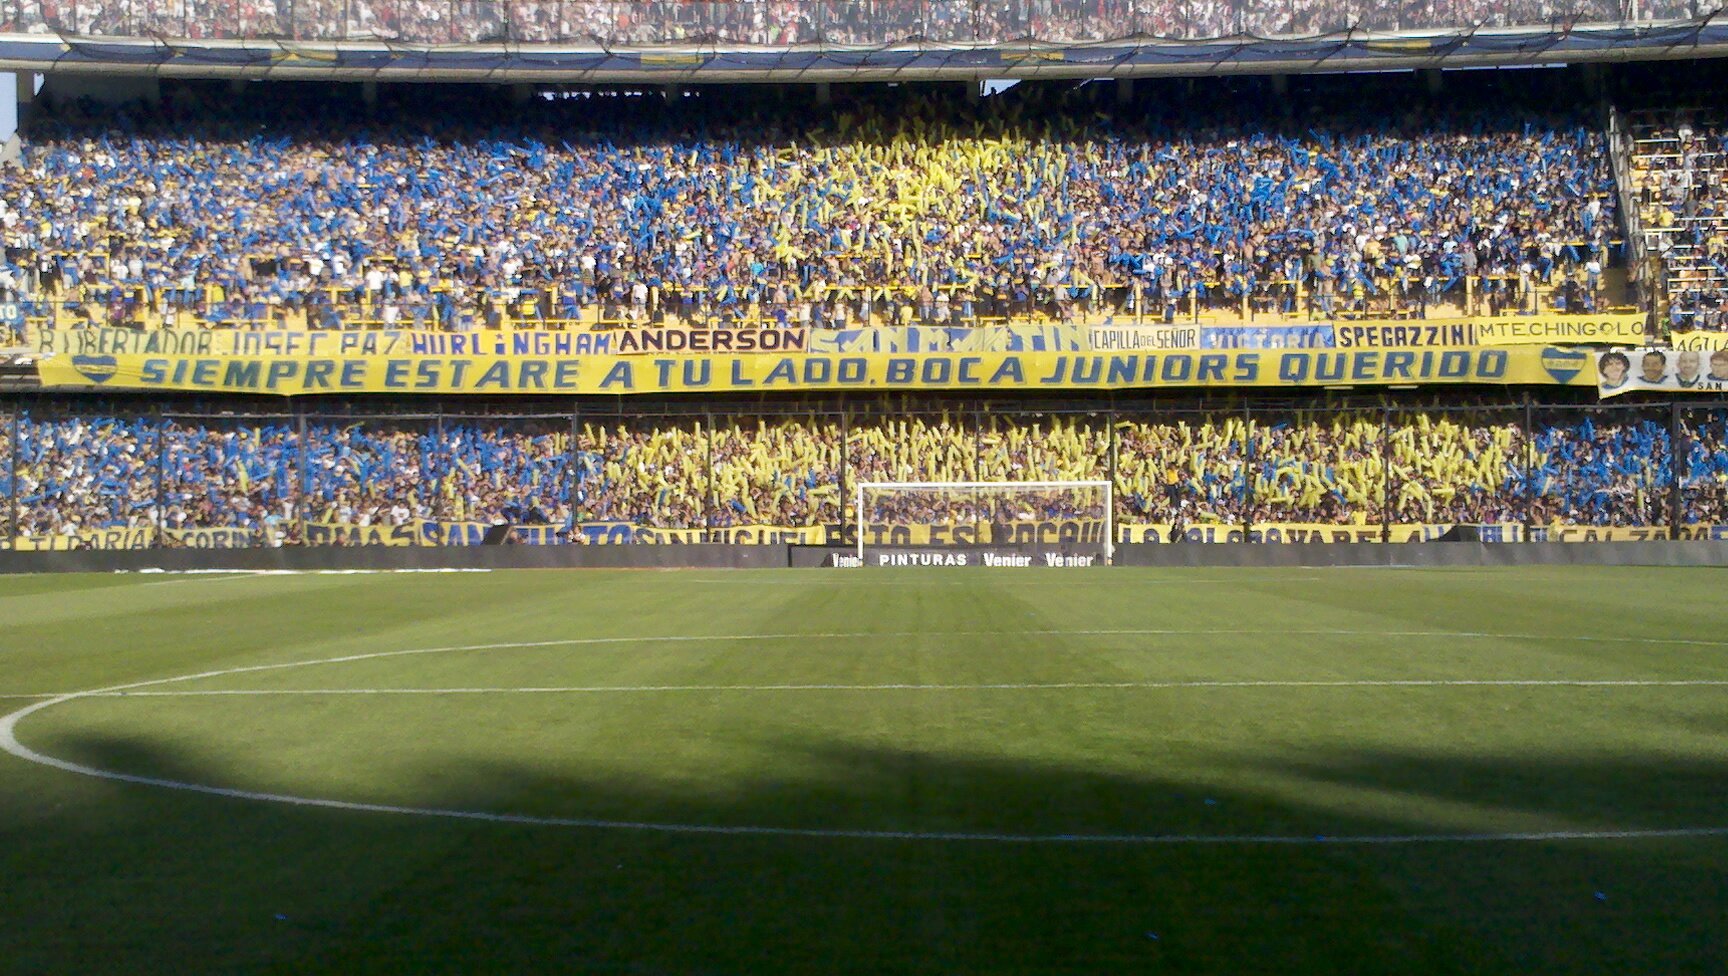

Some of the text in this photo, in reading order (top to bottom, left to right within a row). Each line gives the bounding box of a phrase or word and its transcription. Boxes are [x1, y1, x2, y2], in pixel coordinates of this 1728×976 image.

[619, 329, 805, 351] ANDERSON
[1094, 330, 1139, 350] CAPILLA
[1157, 327, 1196, 349] SEÑOR
[1339, 323, 1474, 347] SPEGAZZINI
[140, 358, 367, 389] SIEMPRE
[384, 359, 579, 390] ESTARE
[600, 360, 635, 389] A
[654, 359, 712, 387] TU
[886, 356, 1026, 384] BOCA
[1040, 354, 1259, 384] JUNIORS
[1279, 350, 1509, 385] QUERIDO
[879, 553, 968, 566] PINTURAS
[983, 552, 1032, 567] Venier
[1045, 552, 1094, 567] Venier
